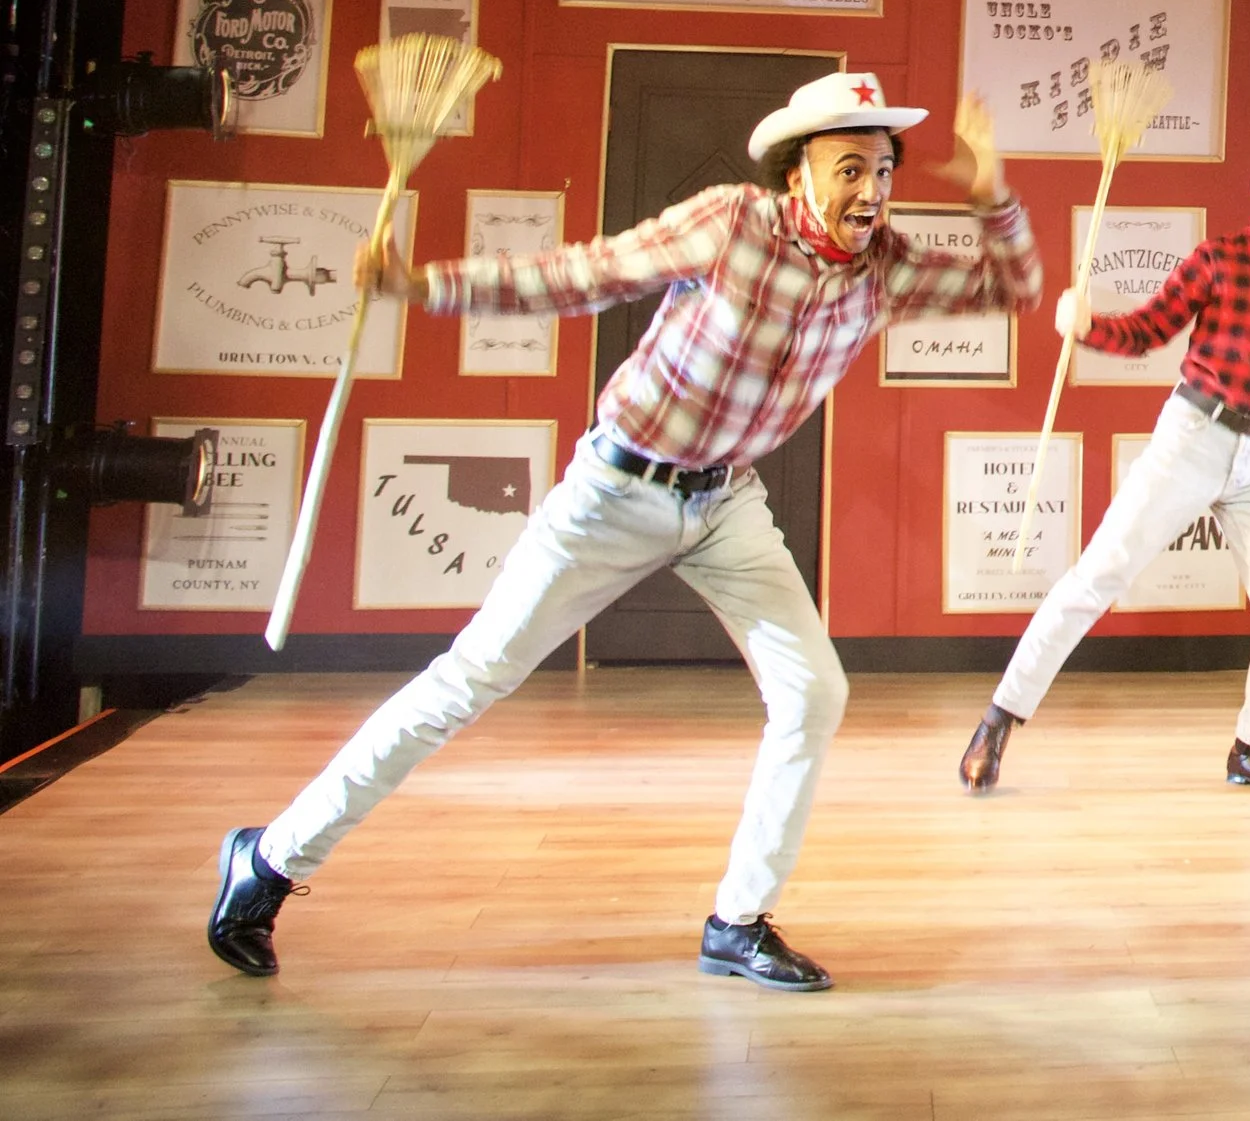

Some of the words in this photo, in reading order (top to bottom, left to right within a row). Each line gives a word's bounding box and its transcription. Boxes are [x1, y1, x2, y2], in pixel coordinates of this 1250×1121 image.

[987, 1, 1052, 19] UNCLE
[991, 23, 1074, 41] JOCKO'S
[1051, 43, 1171, 132] SHW
[193, 203, 298, 246] PENNYWISE
[302, 207, 314, 217] &
[319, 208, 374, 242] STRON
[1114, 278, 1162, 296] PALACE
[187, 281, 275, 331] PLUMBING
[278, 320, 291, 331] &
[911, 339, 984, 357] OMAHA
[219, 436, 267, 448] NNUAL
[203, 472, 244, 488] BEE
[1006, 482, 1020, 495] &
[956, 500, 1069, 516] RESTAUANT
[374, 474, 467, 576] TULSA
[998, 530, 1031, 542] ME
[1035, 530, 1043, 541] A
[986, 547, 1039, 559] MINE'
[188, 559, 248, 570] PUTNAM
[172, 579, 235, 591] COUNTY,
[239, 580, 260, 590] NY
[1013, 591, 1050, 601] COLOR
